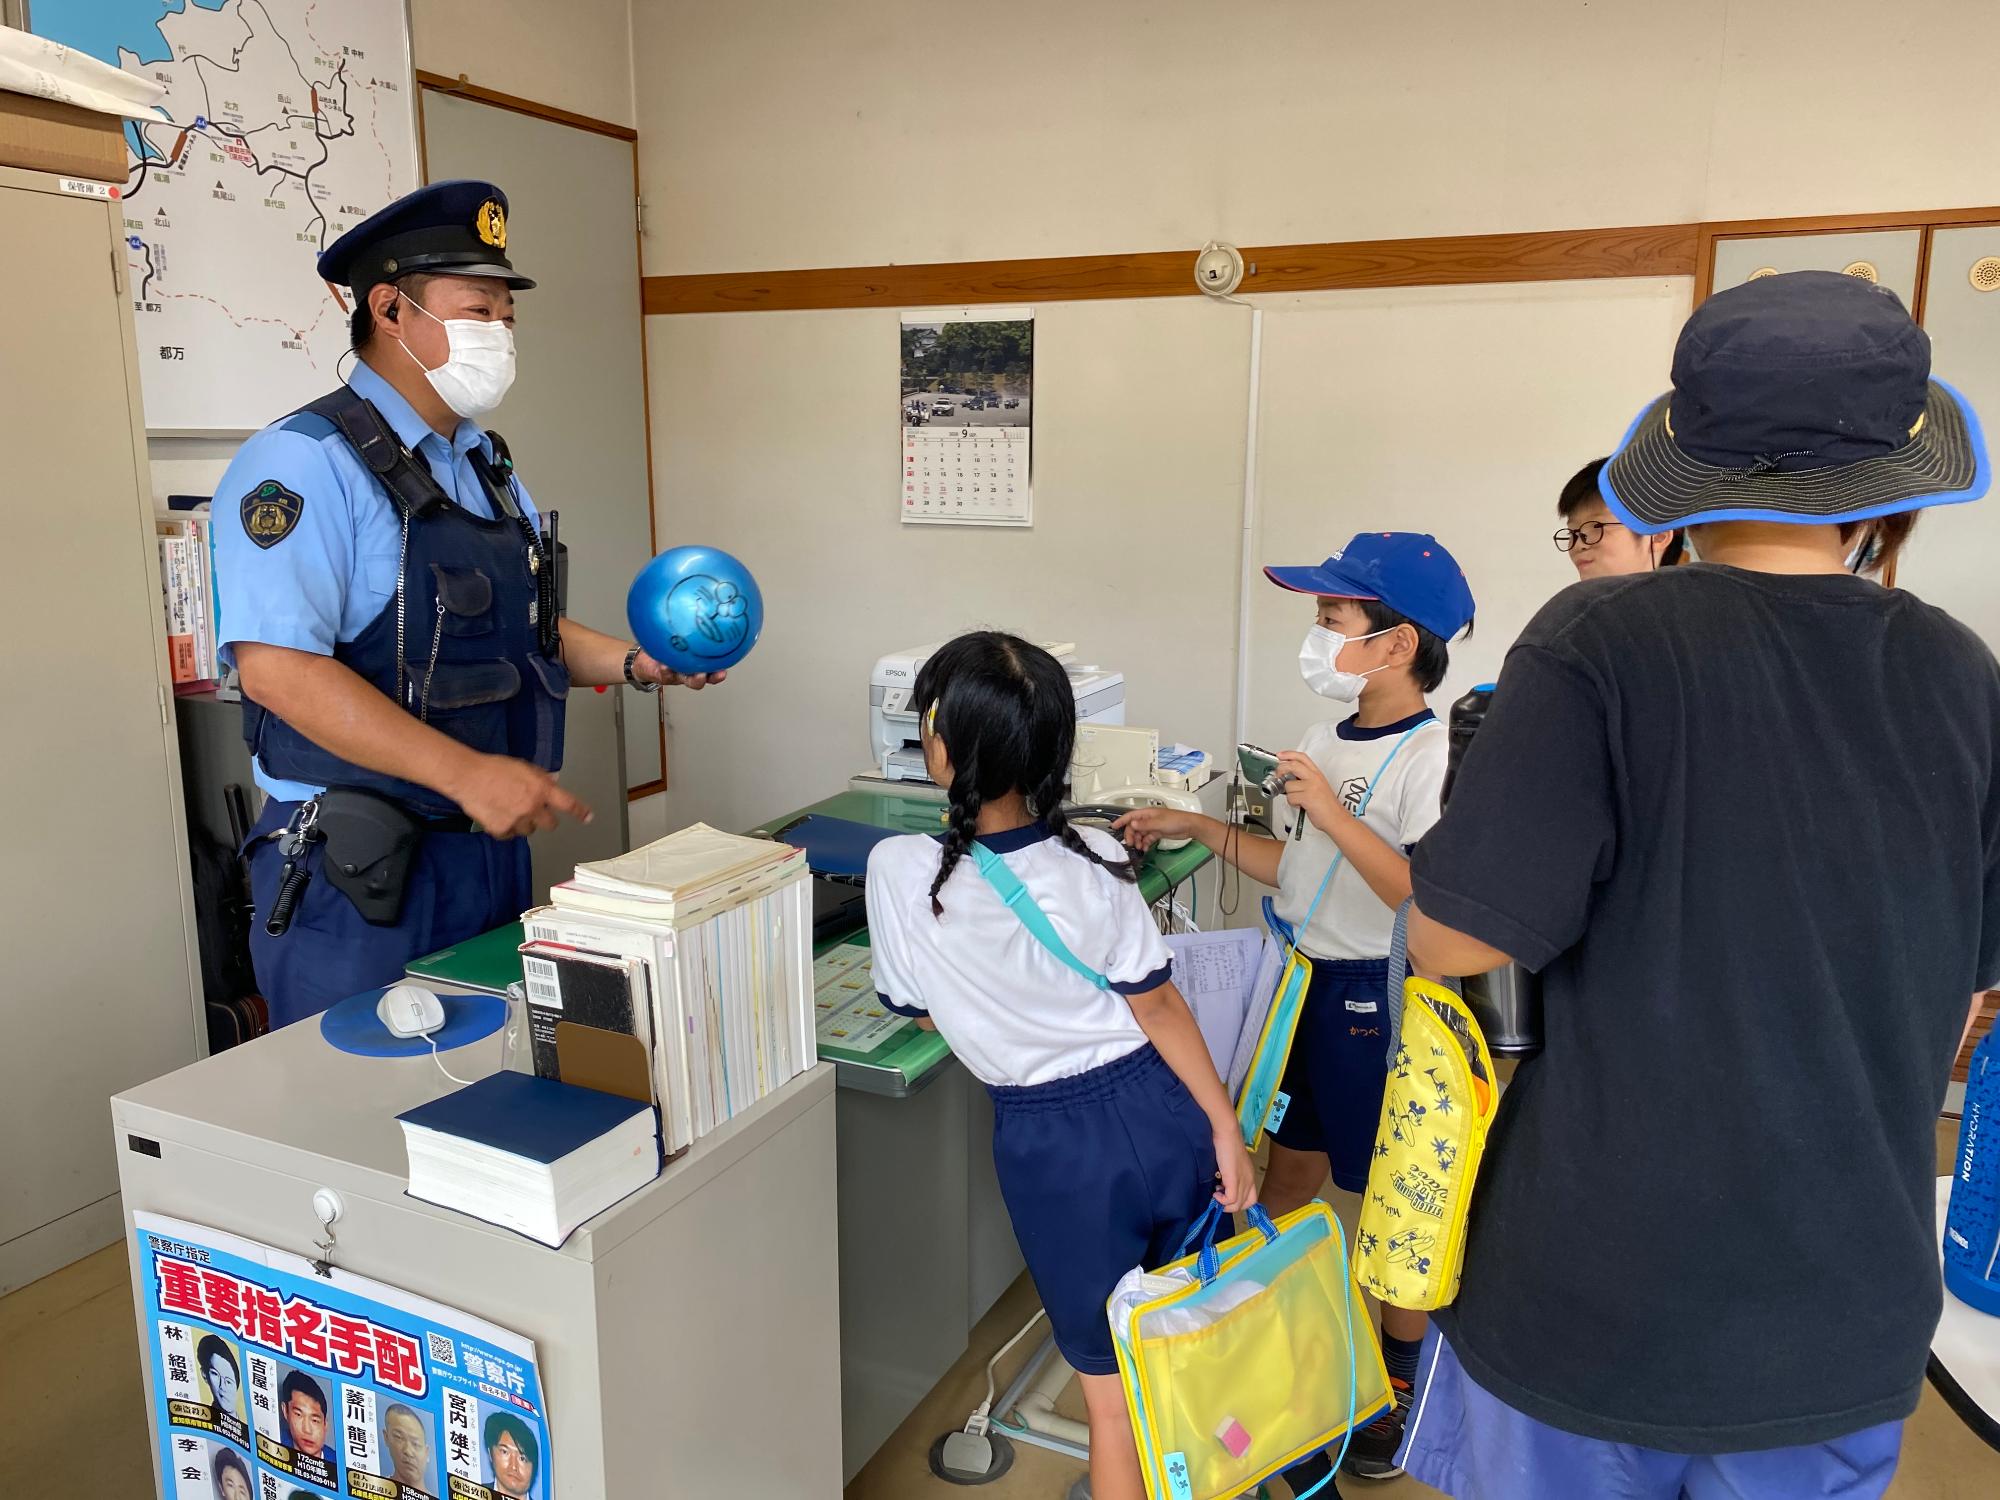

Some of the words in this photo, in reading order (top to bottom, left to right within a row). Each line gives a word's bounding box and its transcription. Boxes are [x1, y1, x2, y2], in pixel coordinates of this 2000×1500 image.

[68, 181, 94, 193] 保管庫
[99, 186, 105, 195] 2
[154, 218, 170, 228] 北山
[146, 302, 162, 313] 都万
[160, 346, 184, 360] 都万
[961, 429, 968, 438] 9
[885, 669, 906, 677] EPSON
[1961, 1102, 1981, 1182] HYDRATION
[149, 1235, 211, 1264] 警察庁指定
[158, 1258, 424, 1394] 重要指名手配
[164, 1325, 183, 1341] 林
[251, 1357, 268, 1390] 吉屋
[463, 1351, 526, 1394] 警察庁
[253, 1391, 270, 1411] 強
[346, 1388, 366, 1423] 菱川
[173, 1404, 208, 1417] 強盗殺人
[448, 1393, 468, 1429] 宮内
[178, 1439, 198, 1452] 李
[347, 1425, 367, 1458] 龍己
[450, 1430, 470, 1466] 雄大
[296, 1452, 326, 1468] 172cm位
[181, 1466, 201, 1481] 会
[261, 1472, 277, 1500] 越智
